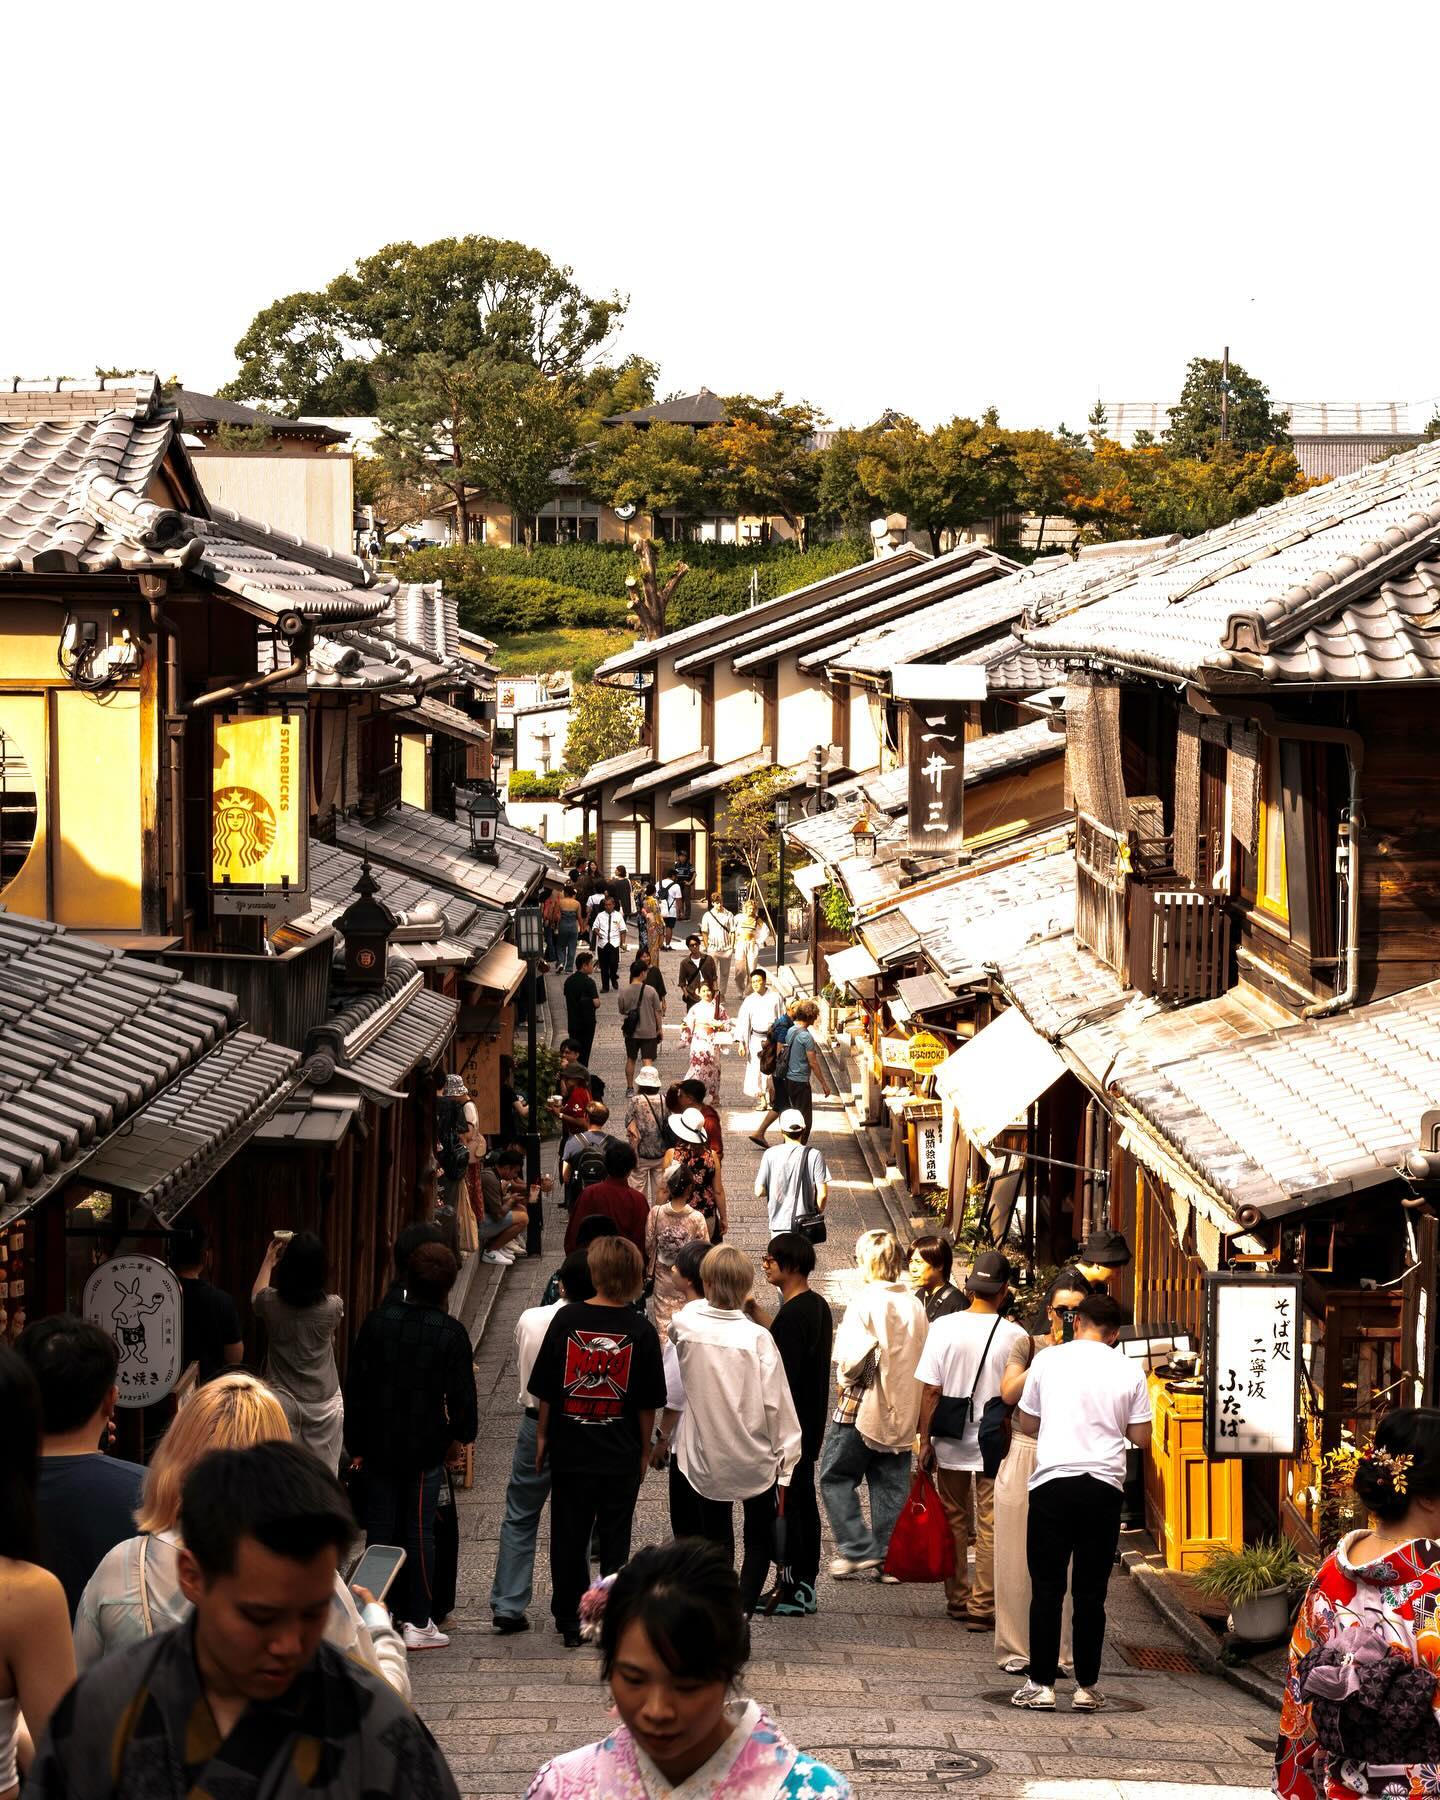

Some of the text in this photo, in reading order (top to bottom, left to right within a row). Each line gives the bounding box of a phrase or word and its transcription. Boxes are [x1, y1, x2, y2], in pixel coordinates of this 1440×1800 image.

[280, 728, 290, 811] STARBUCKS
[920, 714, 957, 832] 二井三
[924, 1128, 937, 1180] 似顔絵商店
[1271, 1298, 1291, 1361] そば処
[116, 1370, 160, 1386] ら焼き
[1247, 1338, 1267, 1400] 二寧坂
[1218, 1369, 1246, 1438] ふたば
